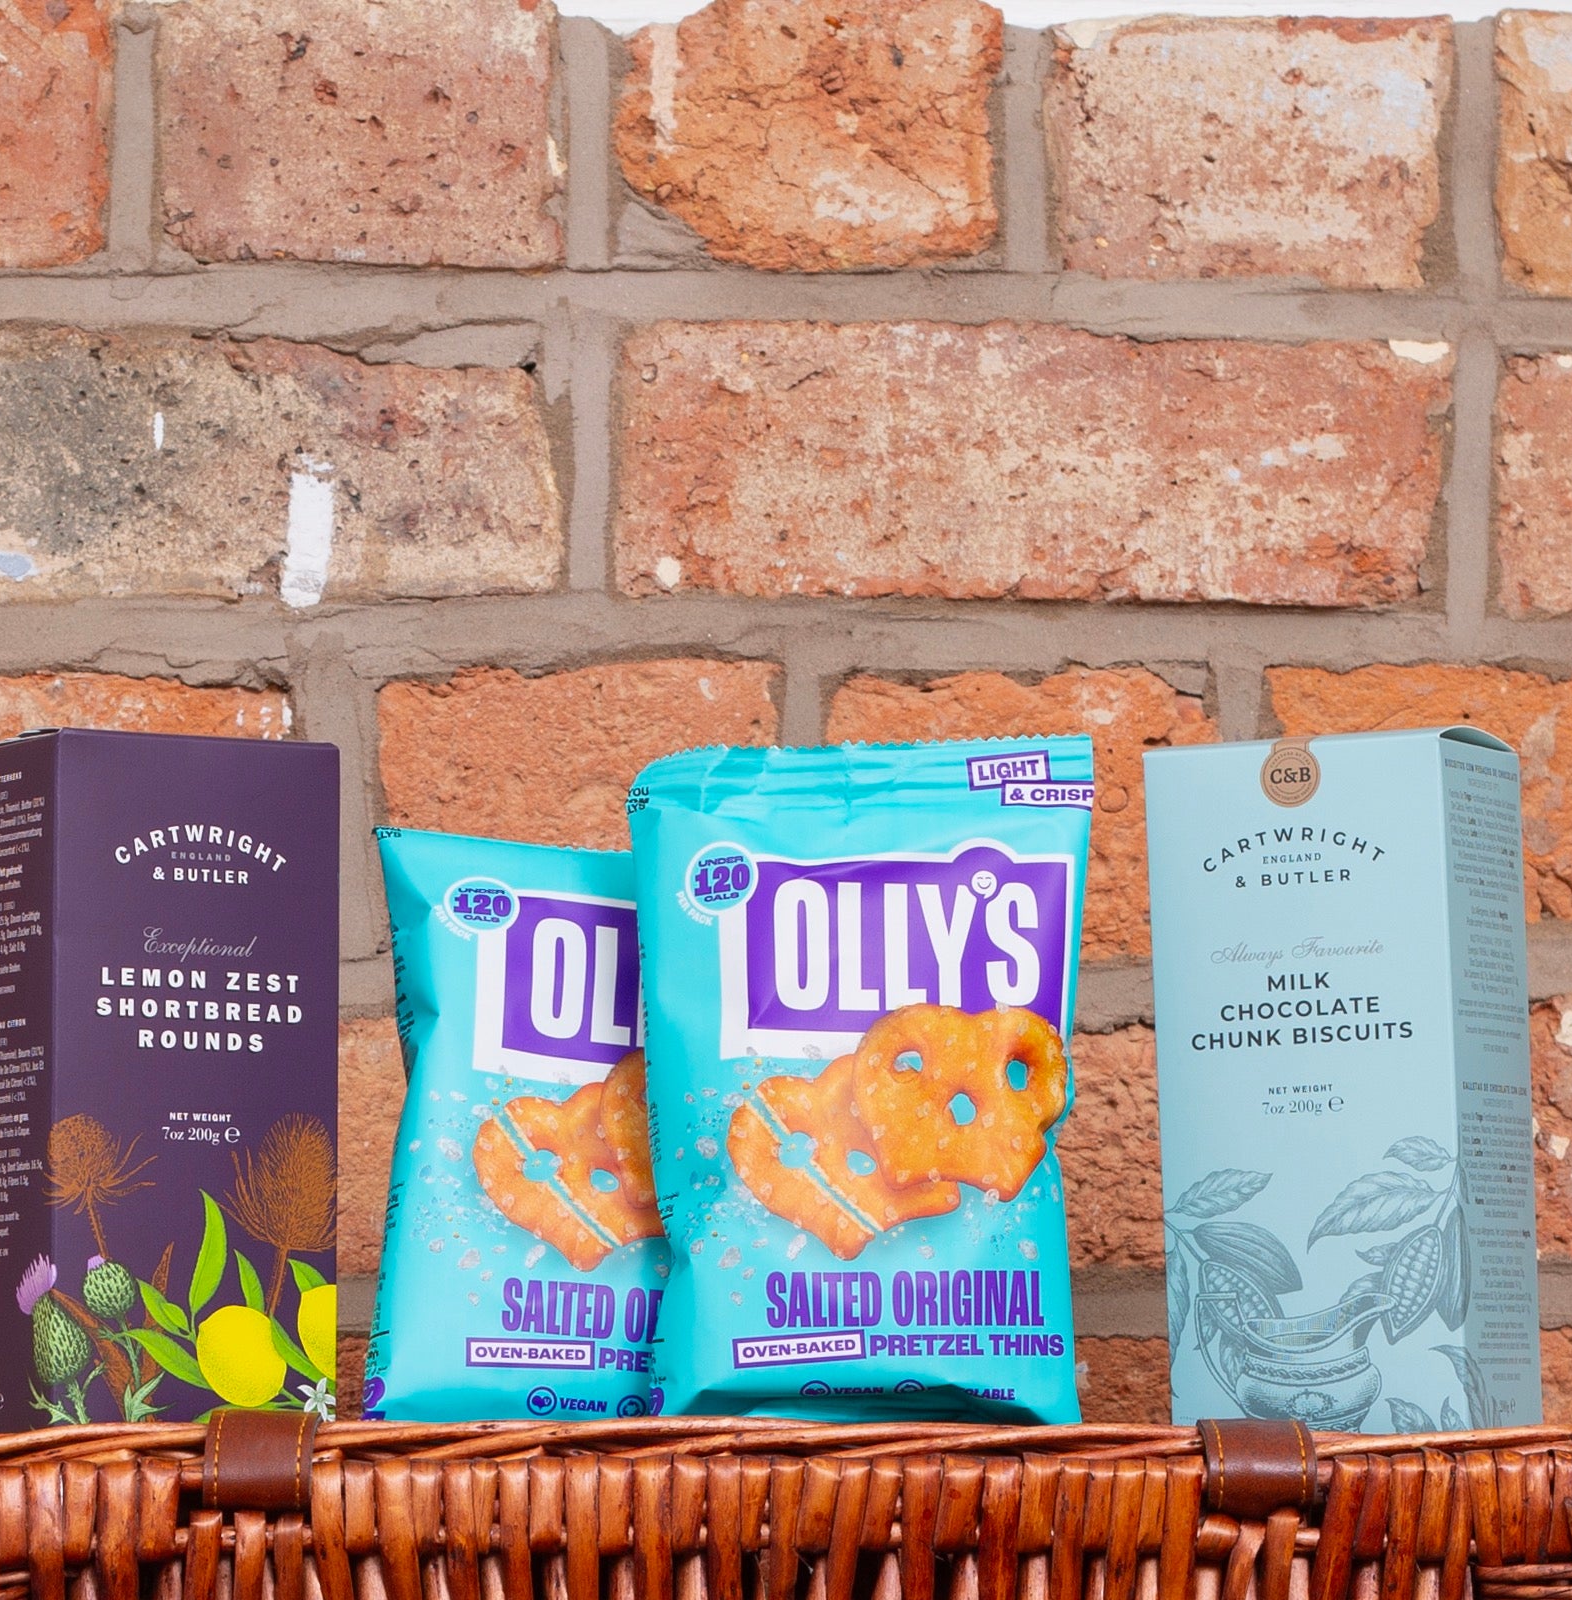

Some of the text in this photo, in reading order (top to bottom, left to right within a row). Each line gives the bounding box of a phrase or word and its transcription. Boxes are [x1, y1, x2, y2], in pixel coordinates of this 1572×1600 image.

[976, 758, 1040, 782] LIGHT
[1270, 766, 1312, 785] C&B
[1008, 786, 1095, 803] & CRISP
[113, 823, 288, 874] CARTWRIGHT
[170, 850, 232, 863] ENGLAND
[1202, 826, 1386, 873] CARTWRIGHT
[1261, 851, 1323, 865] ENGLAND
[698, 855, 744, 868] UNDER
[152, 866, 250, 885] & BUTLER
[694, 863, 751, 897] 120
[1234, 868, 1353, 889] & BUTLER
[703, 891, 740, 903] CALS
[142, 925, 259, 963] Exceptional
[772, 867, 1041, 1014] OLLY'S
[1209, 935, 1385, 969] Always Favourite
[100, 966, 300, 994] LEMON ZEST
[1267, 971, 1331, 993] MILK
[95, 997, 304, 1025] SHORTBREAD
[1219, 995, 1381, 1023] CHOCOLATE
[137, 1028, 266, 1053] ROUNDS
[1190, 1020, 1415, 1052] CHUNK BISCUITS
[1267, 1083, 1335, 1096] NET WEIGHT
[168, 1111, 232, 1124] NET WEIGHT
[1261, 1099, 1324, 1117] 7oz 200g
[161, 1125, 221, 1146] 7oz 200g
[501, 1276, 616, 1340] SALTED
[765, 1268, 1046, 1330] SALTED ORIGINAL
[474, 1346, 587, 1362] OVEN-BAKED
[741, 1332, 1066, 1360] OVEN-BAKED PRETZEL THINS
